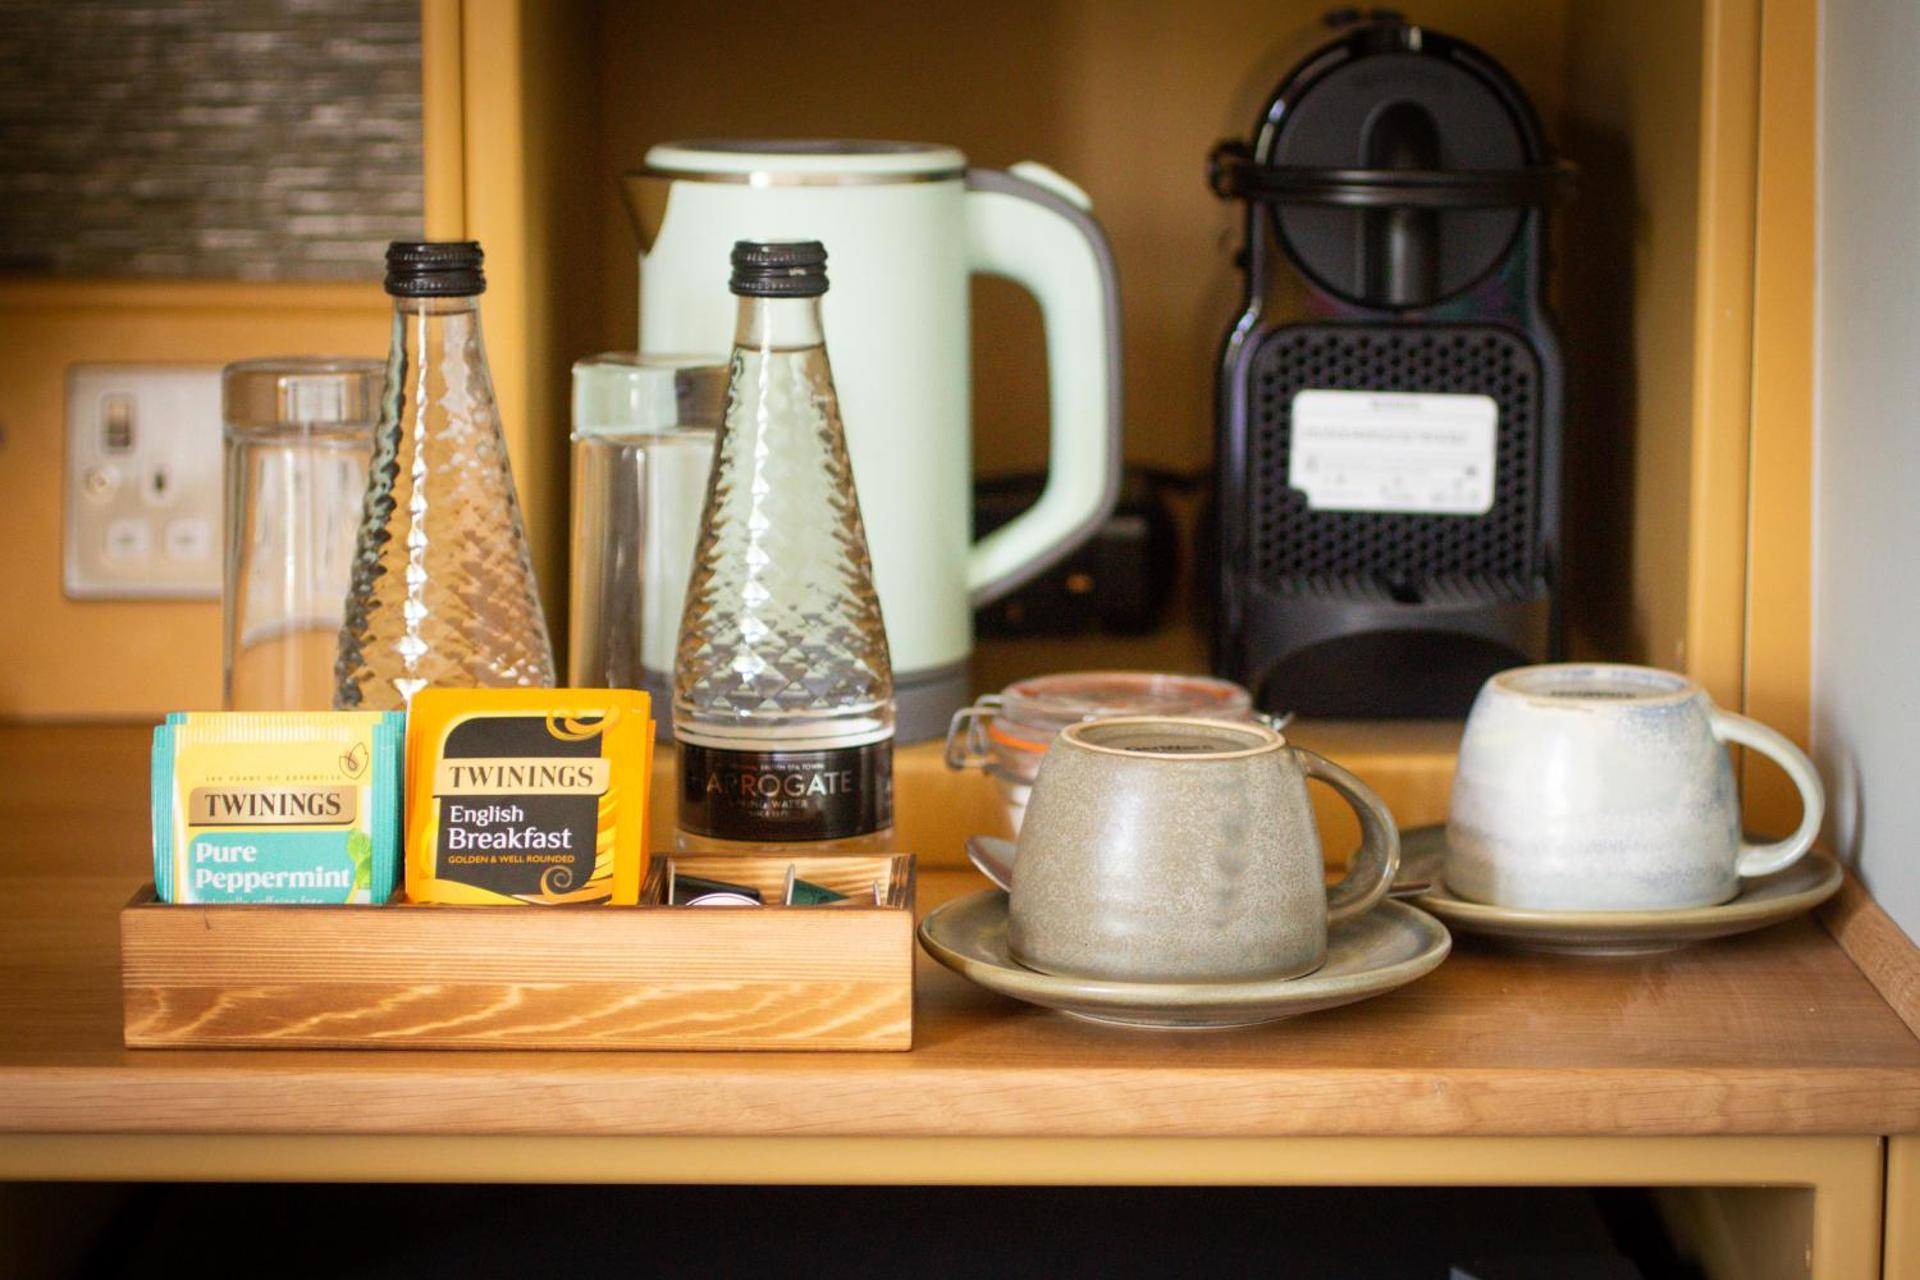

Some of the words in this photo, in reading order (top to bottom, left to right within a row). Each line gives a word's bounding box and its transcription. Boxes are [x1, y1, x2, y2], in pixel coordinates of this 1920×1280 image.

[450, 765, 593, 788] TWININGS
[690, 770, 853, 797] ARROGATE
[205, 793, 341, 816] TWININGS
[450, 805, 524, 826] English
[448, 827, 572, 849] Breakfast
[196, 842, 257, 862] Pure
[448, 855, 489, 864] GOLDEN
[499, 855, 525, 863] WELL
[526, 855, 576, 863] ROUNDED
[195, 866, 350, 893] Peppermint
